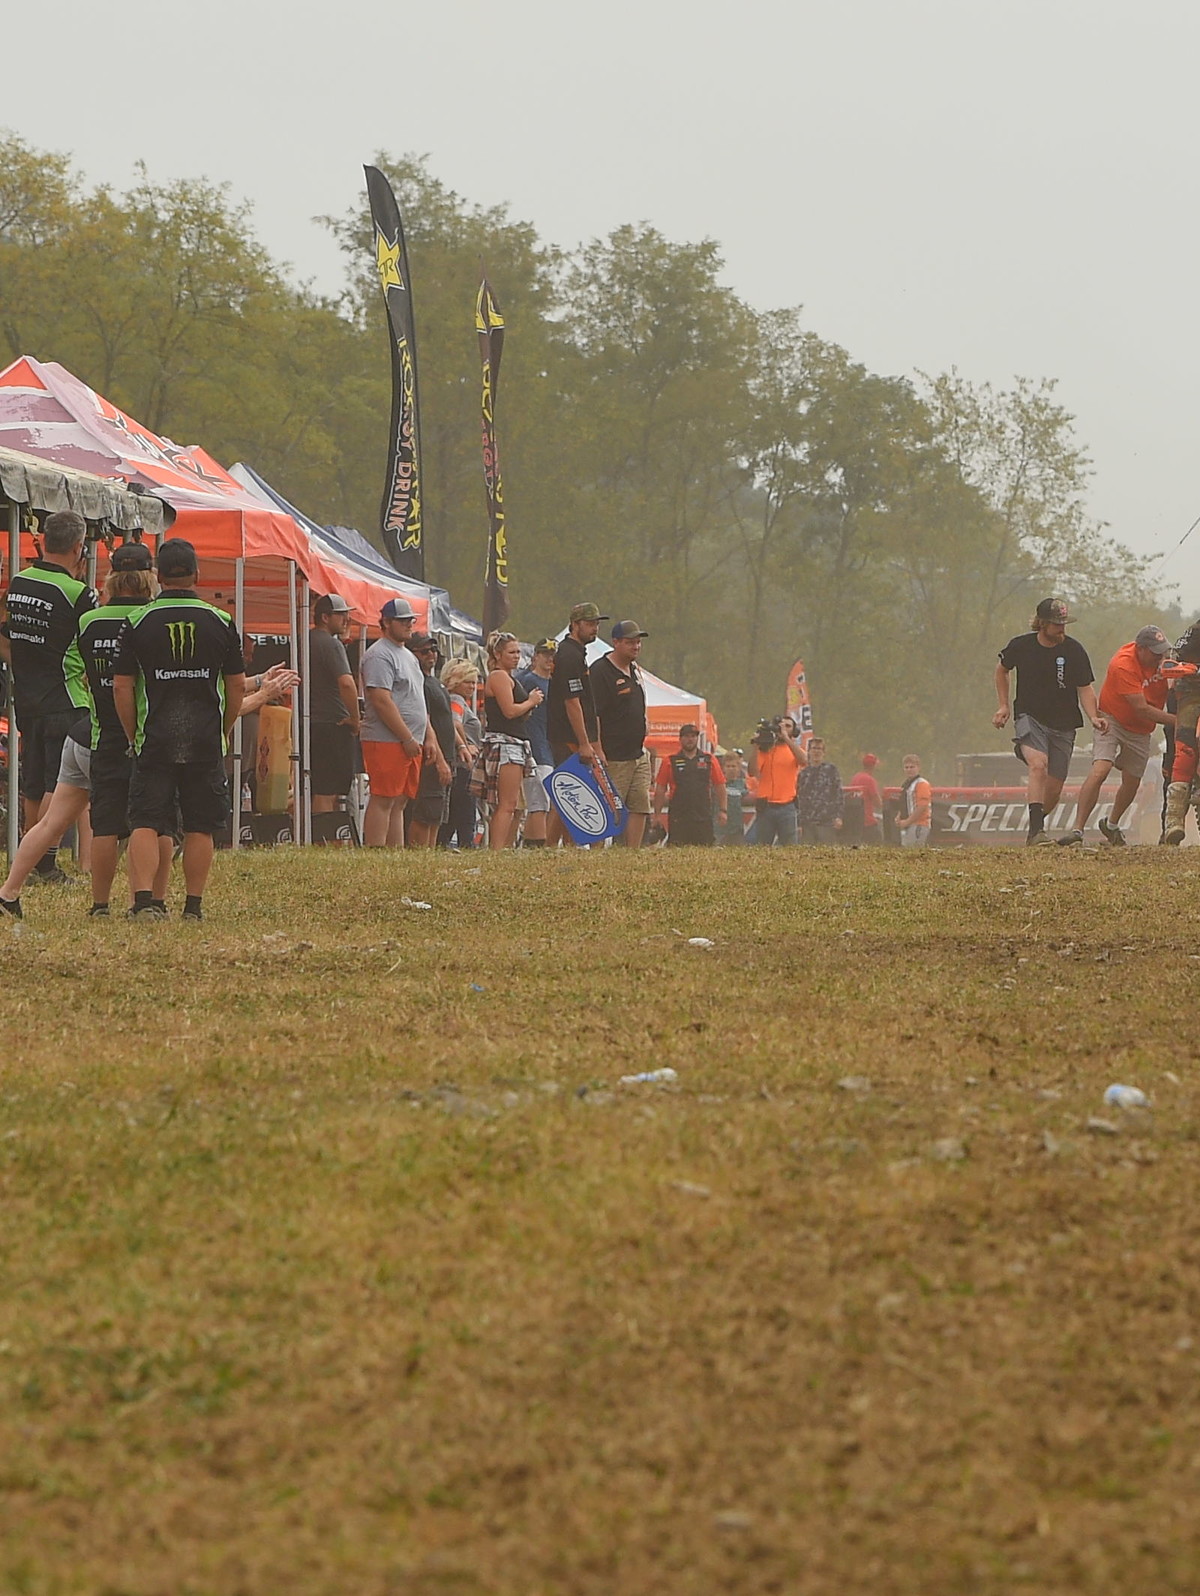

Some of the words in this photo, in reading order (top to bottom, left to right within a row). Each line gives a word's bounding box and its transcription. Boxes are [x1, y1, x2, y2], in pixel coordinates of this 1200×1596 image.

[387, 462, 412, 531] DRINK
[155, 668, 210, 681] Kawasaki
[557, 781, 581, 811] Motion
[580, 804, 599, 825] Pro
[941, 803, 1138, 832] SPECILIZED
